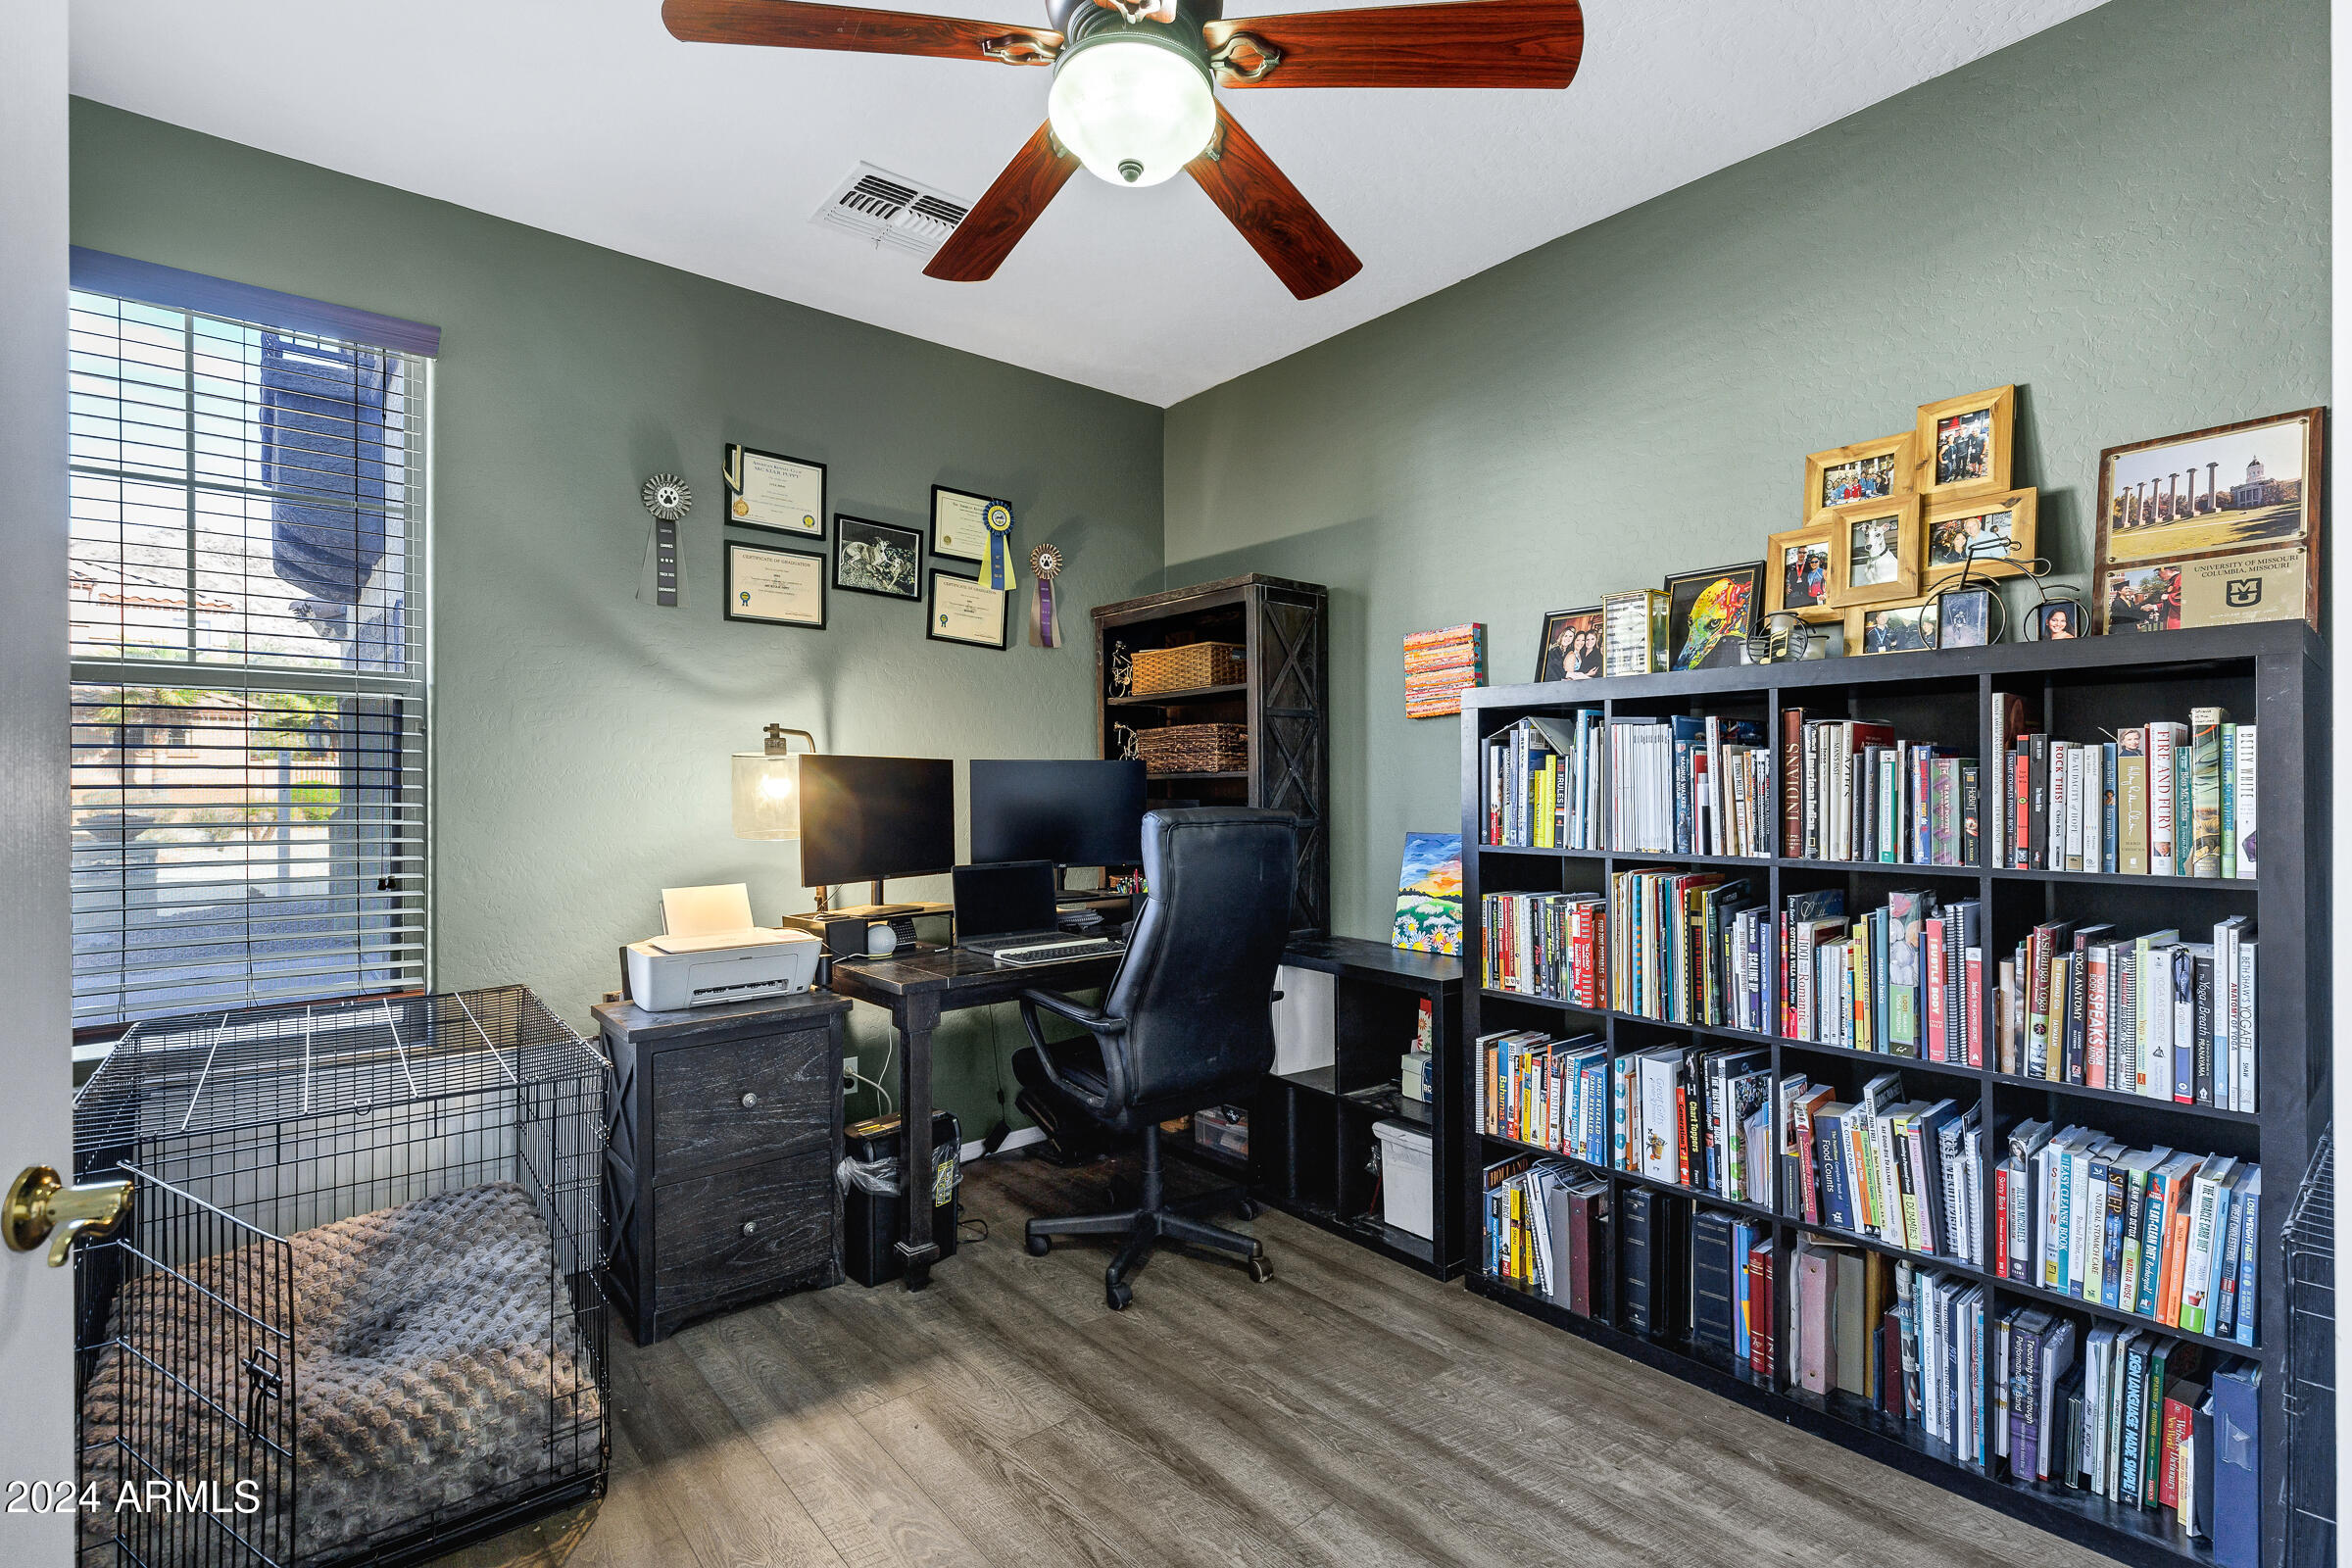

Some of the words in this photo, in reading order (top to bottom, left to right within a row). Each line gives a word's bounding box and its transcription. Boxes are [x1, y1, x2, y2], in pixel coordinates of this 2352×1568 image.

[2194, 561, 2242, 572] UNIVERSITY
[2254, 555, 2298, 565] MISSOURI
[2201, 567, 2245, 578] COLUMBIA,
[2248, 563, 2289, 572] MISSOURI
[2157, 731, 2170, 760] FIRE
[2240, 733, 2254, 762] BETTY
[1786, 743, 1799, 821] INDIANS
[1807, 753, 1817, 799] American
[2158, 765, 2170, 794] AND
[2240, 768, 2254, 798] WHITE
[1966, 787, 1977, 812] HOBBIT
[1807, 801, 1817, 831] Indian
[2158, 798, 2171, 832] FURY
[1798, 942, 1809, 961] 1001
[2038, 933, 2050, 983] Ashtanga
[2075, 952, 2083, 976] YOGA
[1748, 953, 1758, 982] SCALING
[1748, 984, 1758, 993] UP
[1798, 973, 1809, 1023] Romantic
[2038, 986, 2049, 1011] Yoga
[2074, 977, 2082, 1021] ANATOMY
[2089, 994, 2103, 1046] SPEAKS
[2231, 1019, 2237, 1029] OF
[2240, 1005, 2251, 1051] YOGAFIT
[1690, 1123, 1699, 1152] Toppers
[1823, 1139, 1833, 1160] Food
[1824, 1163, 1835, 1192] Counts
[2132, 1173, 2141, 1185] THE
[2202, 1184, 2214, 1196] THE
[2017, 1187, 2026, 1209] JILLIAN
[2107, 1174, 2124, 1214] SLEEP
[2132, 1186, 2140, 1200] RAW
[1906, 1200, 1918, 1239] DUMMIES
[2130, 1201, 2139, 1217] FOOD
[2199, 1197, 2213, 1222] MIRACLE
[2246, 1198, 2255, 1215] LOSE
[2017, 1210, 2026, 1243] MICHAELS
[2059, 1226, 2068, 1250] BOOK
[2092, 1219, 2101, 1257] STOMACH
[2129, 1218, 2138, 1239] DETOX
[2198, 1223, 2211, 1239] CARB
[2245, 1216, 2255, 1244] WEIGHT
[2128, 1239, 2136, 1252] DIET
[2197, 1241, 2209, 1254] DIET
[2244, 1245, 2253, 1262] HERE
[2125, 1257, 2133, 1282] NATALIA
[2123, 1284, 2132, 1299] ROSE
[1948, 1345, 1957, 1364] 1987
[2025, 1340, 2034, 1374] Teaching
[2128, 1351, 2142, 1376] SIGN
[2025, 1396, 2034, 1424] through
[2126, 1376, 2141, 1427] LANGUAGE
[2168, 1416, 2177, 1429] New
[2174, 1419, 2185, 1451] Webster's
[2125, 1428, 2138, 1458] MADE
[2166, 1429, 2176, 1449] World
[2123, 1457, 2137, 1492] SIMPLE
[2166, 1450, 2180, 1491] Dictionary
